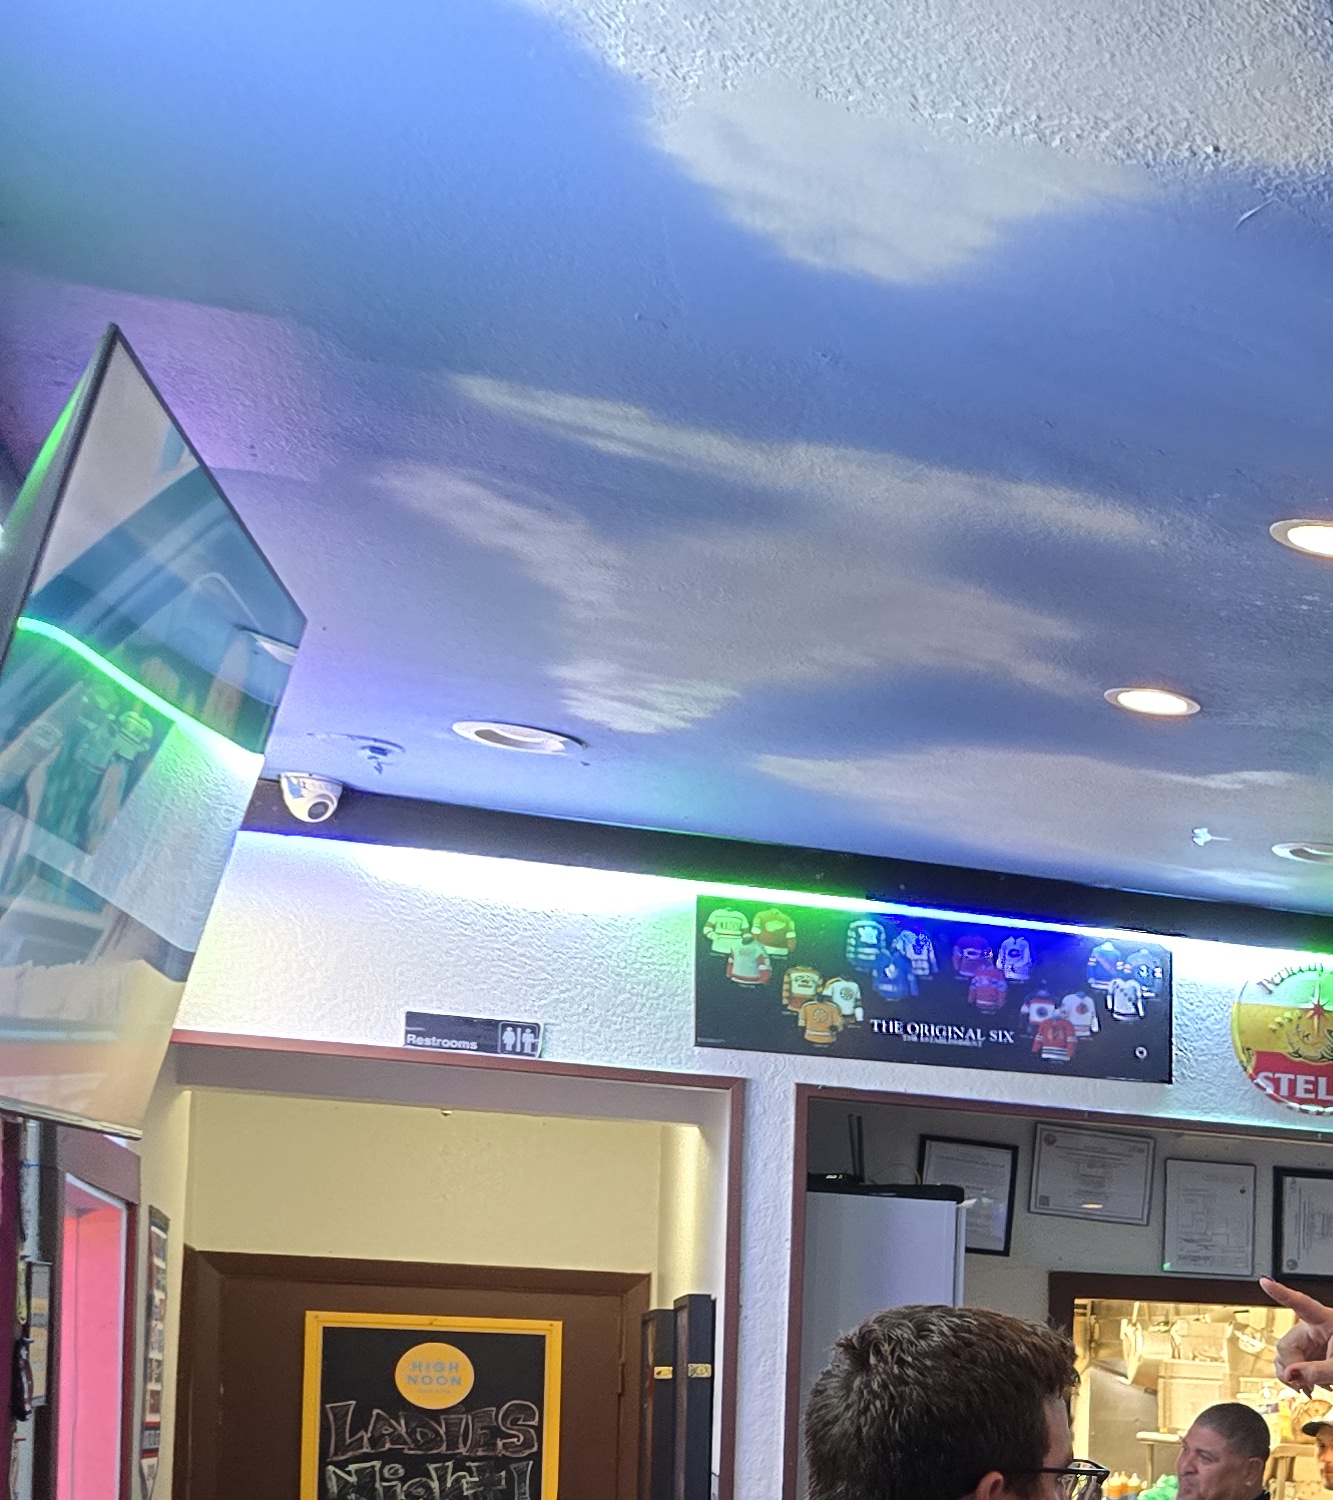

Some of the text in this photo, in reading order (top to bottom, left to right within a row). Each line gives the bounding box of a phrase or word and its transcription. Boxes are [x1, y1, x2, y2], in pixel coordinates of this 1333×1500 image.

[870, 1019, 1015, 1043] THE ORIGINAL SIX
[406, 1033, 477, 1050] Restrooms
[410, 1360, 460, 1373] HIGH
[406, 1374, 462, 1386] NOON
[325, 1400, 538, 1461] LADIES
